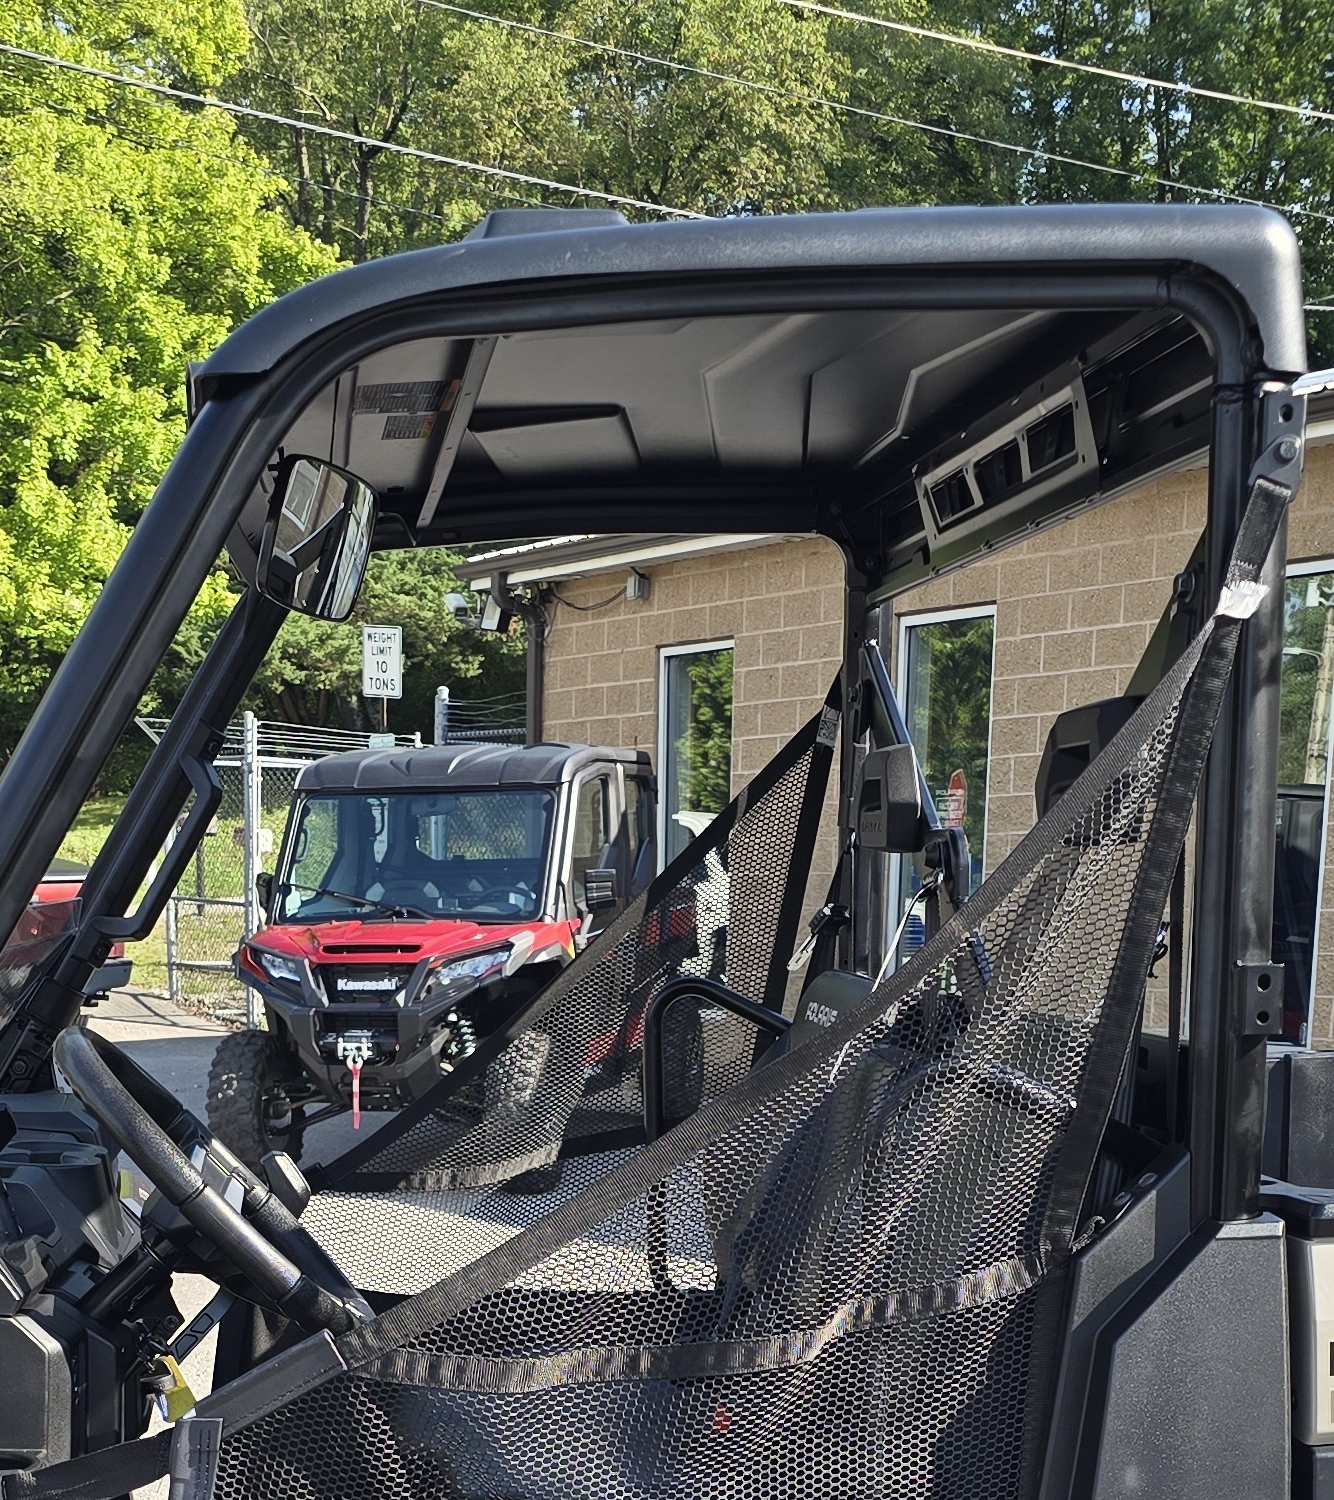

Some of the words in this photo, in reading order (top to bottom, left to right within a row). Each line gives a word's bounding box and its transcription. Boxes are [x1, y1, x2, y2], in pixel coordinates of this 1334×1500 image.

[367, 632, 397, 643] WEIGHT
[371, 646, 392, 656] LIMIT
[376, 661, 388, 673] 10
[369, 677, 396, 691] TONS
[337, 977, 398, 991] Kawasaki
